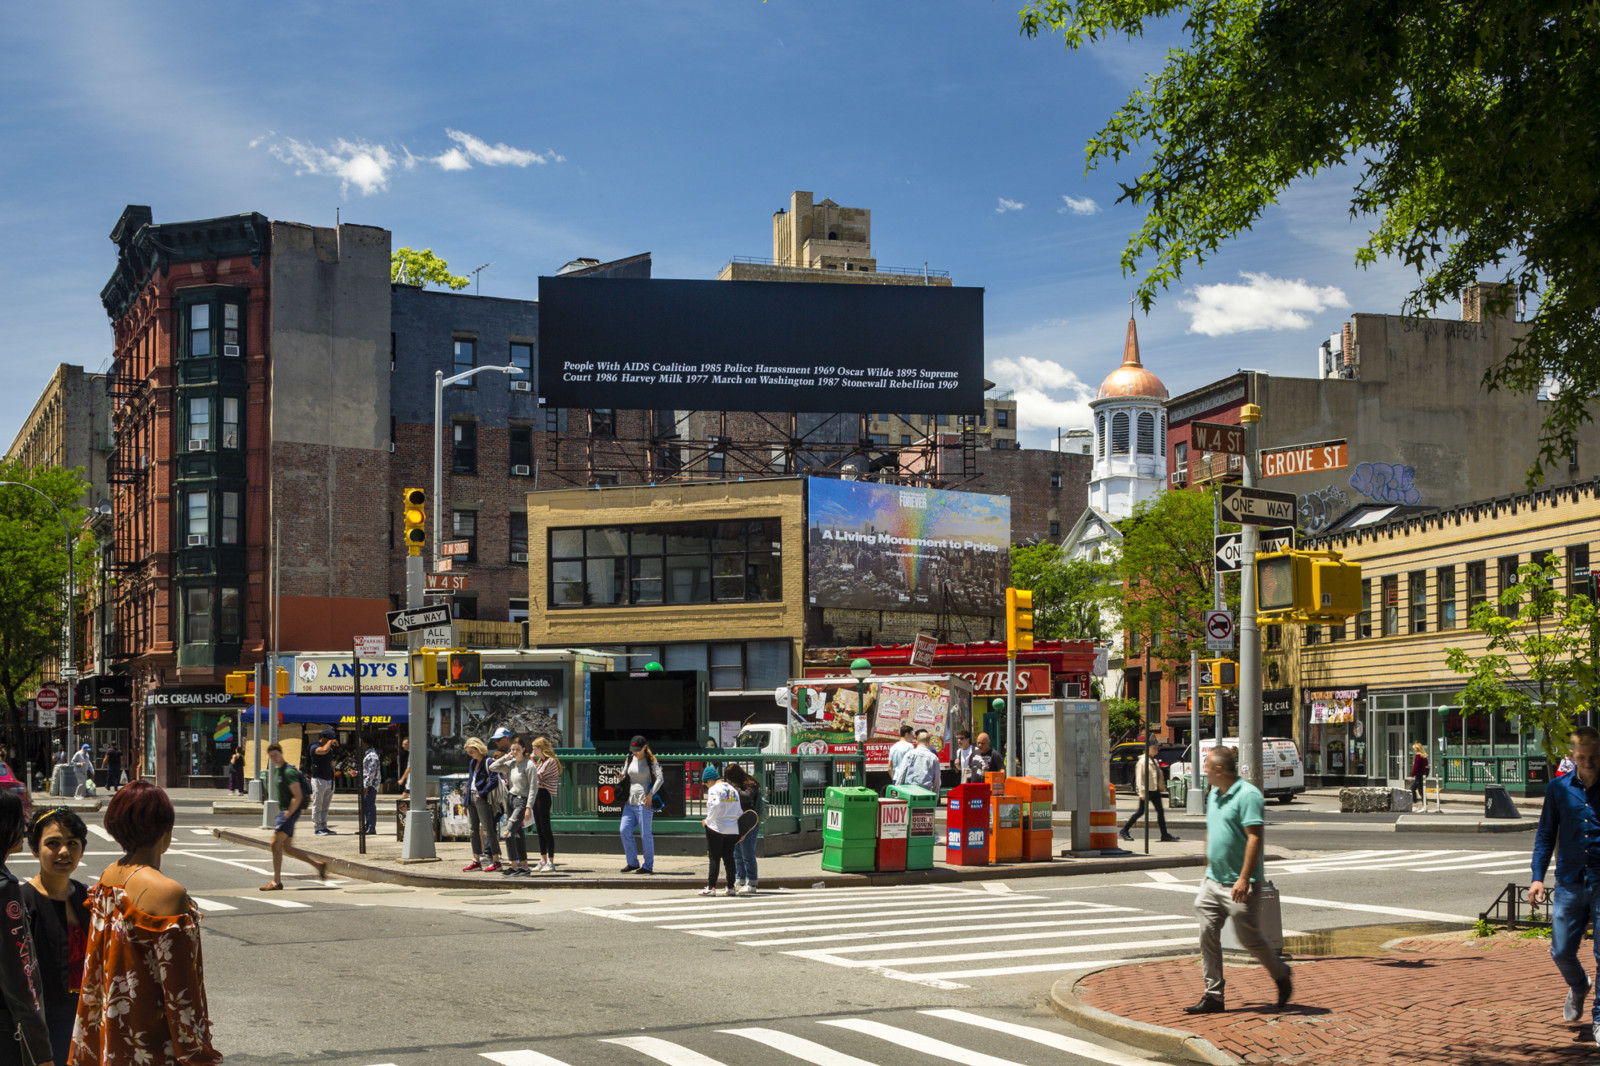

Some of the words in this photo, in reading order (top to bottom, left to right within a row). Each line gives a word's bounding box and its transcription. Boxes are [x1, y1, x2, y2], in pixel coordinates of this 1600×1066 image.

[563, 361, 595, 372] People
[596, 361, 621, 371] With
[622, 362, 650, 372] AIDS
[652, 362, 698, 373] Coalition
[700, 363, 722, 373] 1985
[723, 363, 753, 373] Police
[754, 364, 811, 375] Harassment
[813, 365, 836, 375] 1969
[836, 366, 865, 377] Oscar
[866, 367, 894, 377] Wilde
[896, 368, 918, 378] 1895
[919, 368, 959, 380] Supreme
[562, 372, 592, 382] Court
[595, 373, 618, 382] 1986
[621, 373, 657, 385] Harvey
[658, 374, 683, 384] Milk
[686, 374, 709, 384] 1977
[711, 375, 743, 384] March
[759, 375, 815, 388] Washington
[817, 377, 840, 387] 1987
[841, 377, 887, 388] Stonewall
[888, 379, 935, 389] Rebellion
[937, 380, 959, 390] 1969
[1196, 427, 1207, 449] W
[1213, 432, 1221, 449] 4
[1227, 431, 1242, 452] ST
[1266, 449, 1315, 476] GROVE
[1324, 446, 1341, 468] ST
[899, 496, 927, 509] FOREVER
[1231, 497, 1255, 514] ONE
[1266, 502, 1291, 518] WAY
[454, 542, 468, 552] SOUTH
[822, 529, 833, 540] A
[835, 530, 876, 545] Living
[878, 534, 947, 550] Monument
[949, 540, 962, 551] to
[963, 541, 999, 553] Pride
[1225, 545, 1241, 560] ON
[428, 576, 437, 588] W
[441, 576, 448, 588] 4
[453, 577, 464, 588] ST
[397, 616, 416, 627] ONE
[423, 612, 442, 622] WAY
[428, 629, 445, 637] ALL
[914, 651, 932, 666] CIGARS
[491, 679, 550, 687] Communicate.
[154, 695, 168, 704] ICE
[170, 694, 203, 704] CREAM
[204, 694, 232, 703] SHOP
[511, 689, 522, 697] plan
[1275, 701, 1289, 710] cat
[604, 790, 609, 800] 1
[598, 805, 622, 813] Uptown
[883, 807, 907, 823] INDY
[1032, 810, 1050, 818] metro
[830, 812, 839, 826] M
